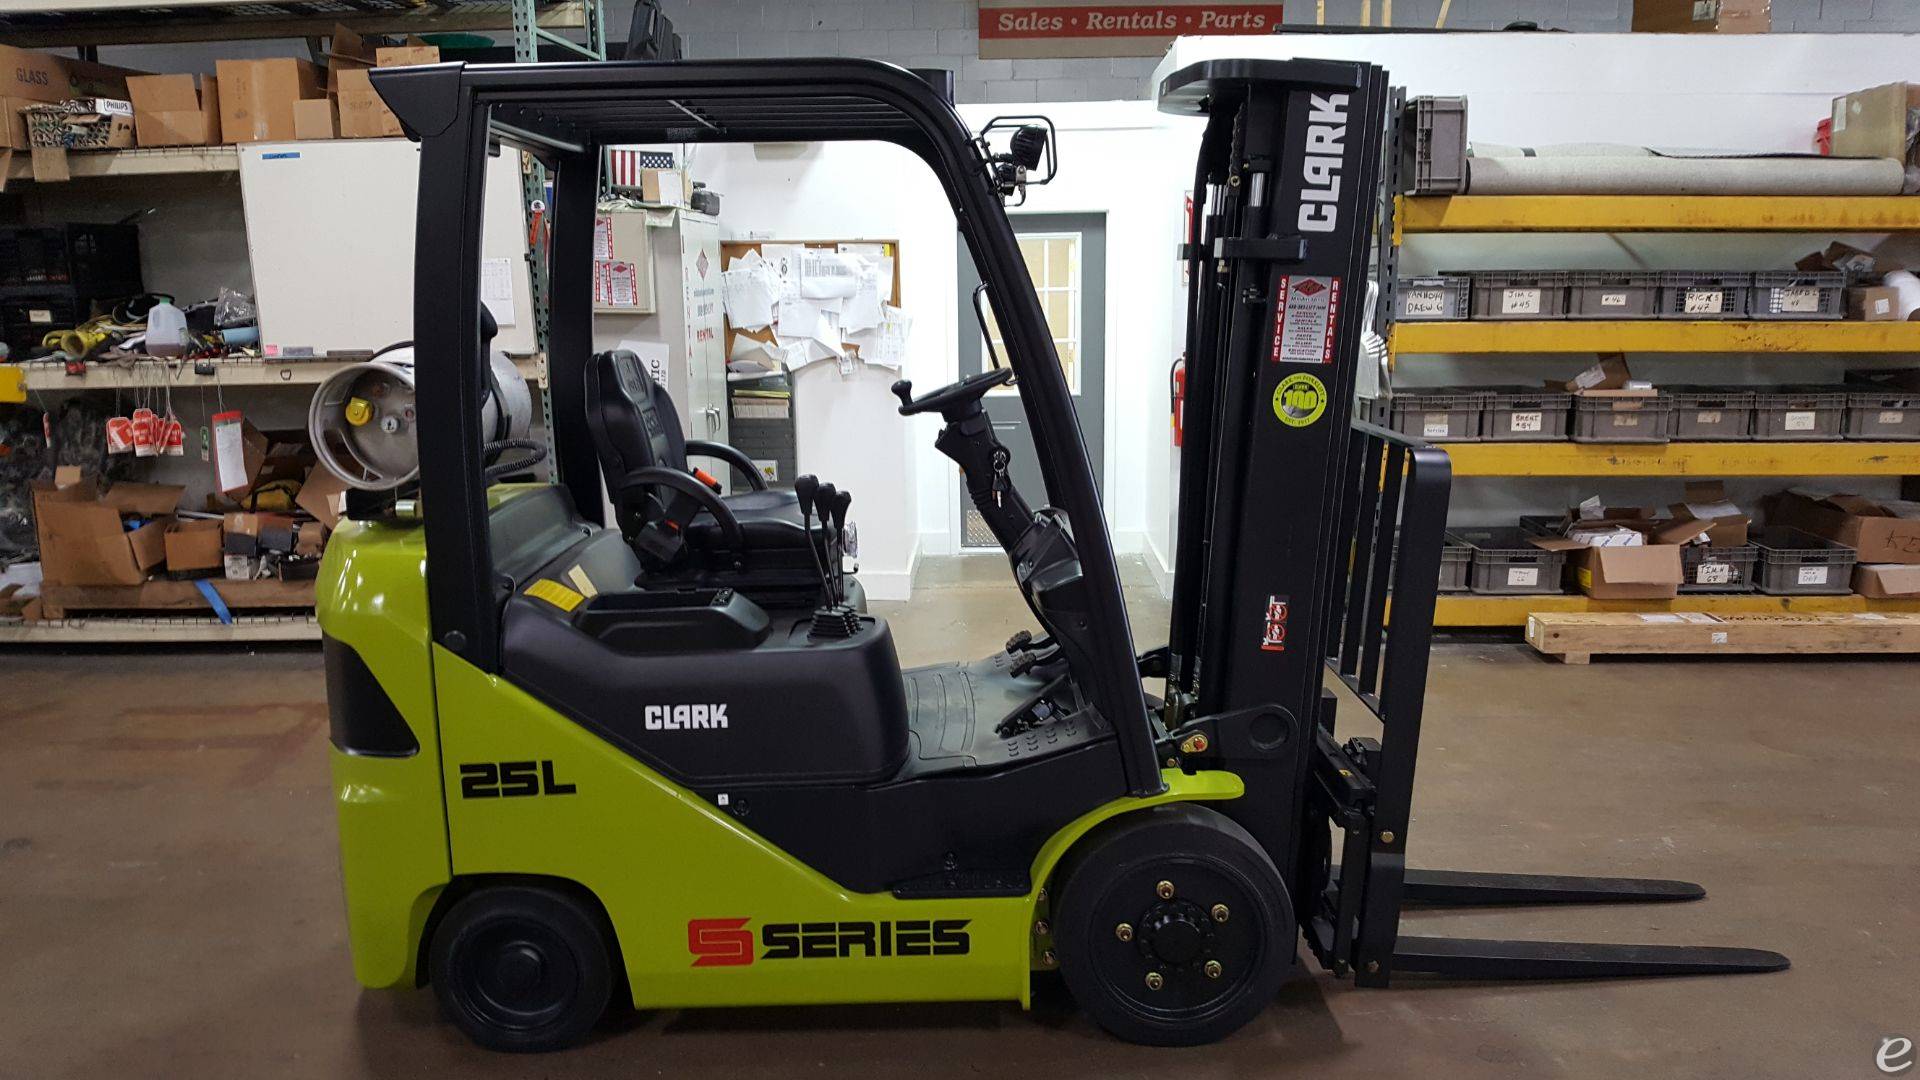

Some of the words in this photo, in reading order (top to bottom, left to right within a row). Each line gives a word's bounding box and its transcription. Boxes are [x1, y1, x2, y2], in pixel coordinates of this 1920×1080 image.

[998, 13, 1063, 31] Sales
[1086, 12, 1177, 30] Rentals
[1199, 10, 1265, 28] Parts
[16, 67, 49, 86] GLASS
[106, 101, 129, 111] PHILIPS
[1298, 93, 1349, 232] CLARK
[1273, 278, 1287, 357] SERVICE
[1325, 280, 1339, 359] RENTALS
[1284, 389, 1318, 410] 100
[644, 703, 728, 730] CLARK
[459, 760, 577, 798] 25L
[760, 919, 972, 960] SERIES
